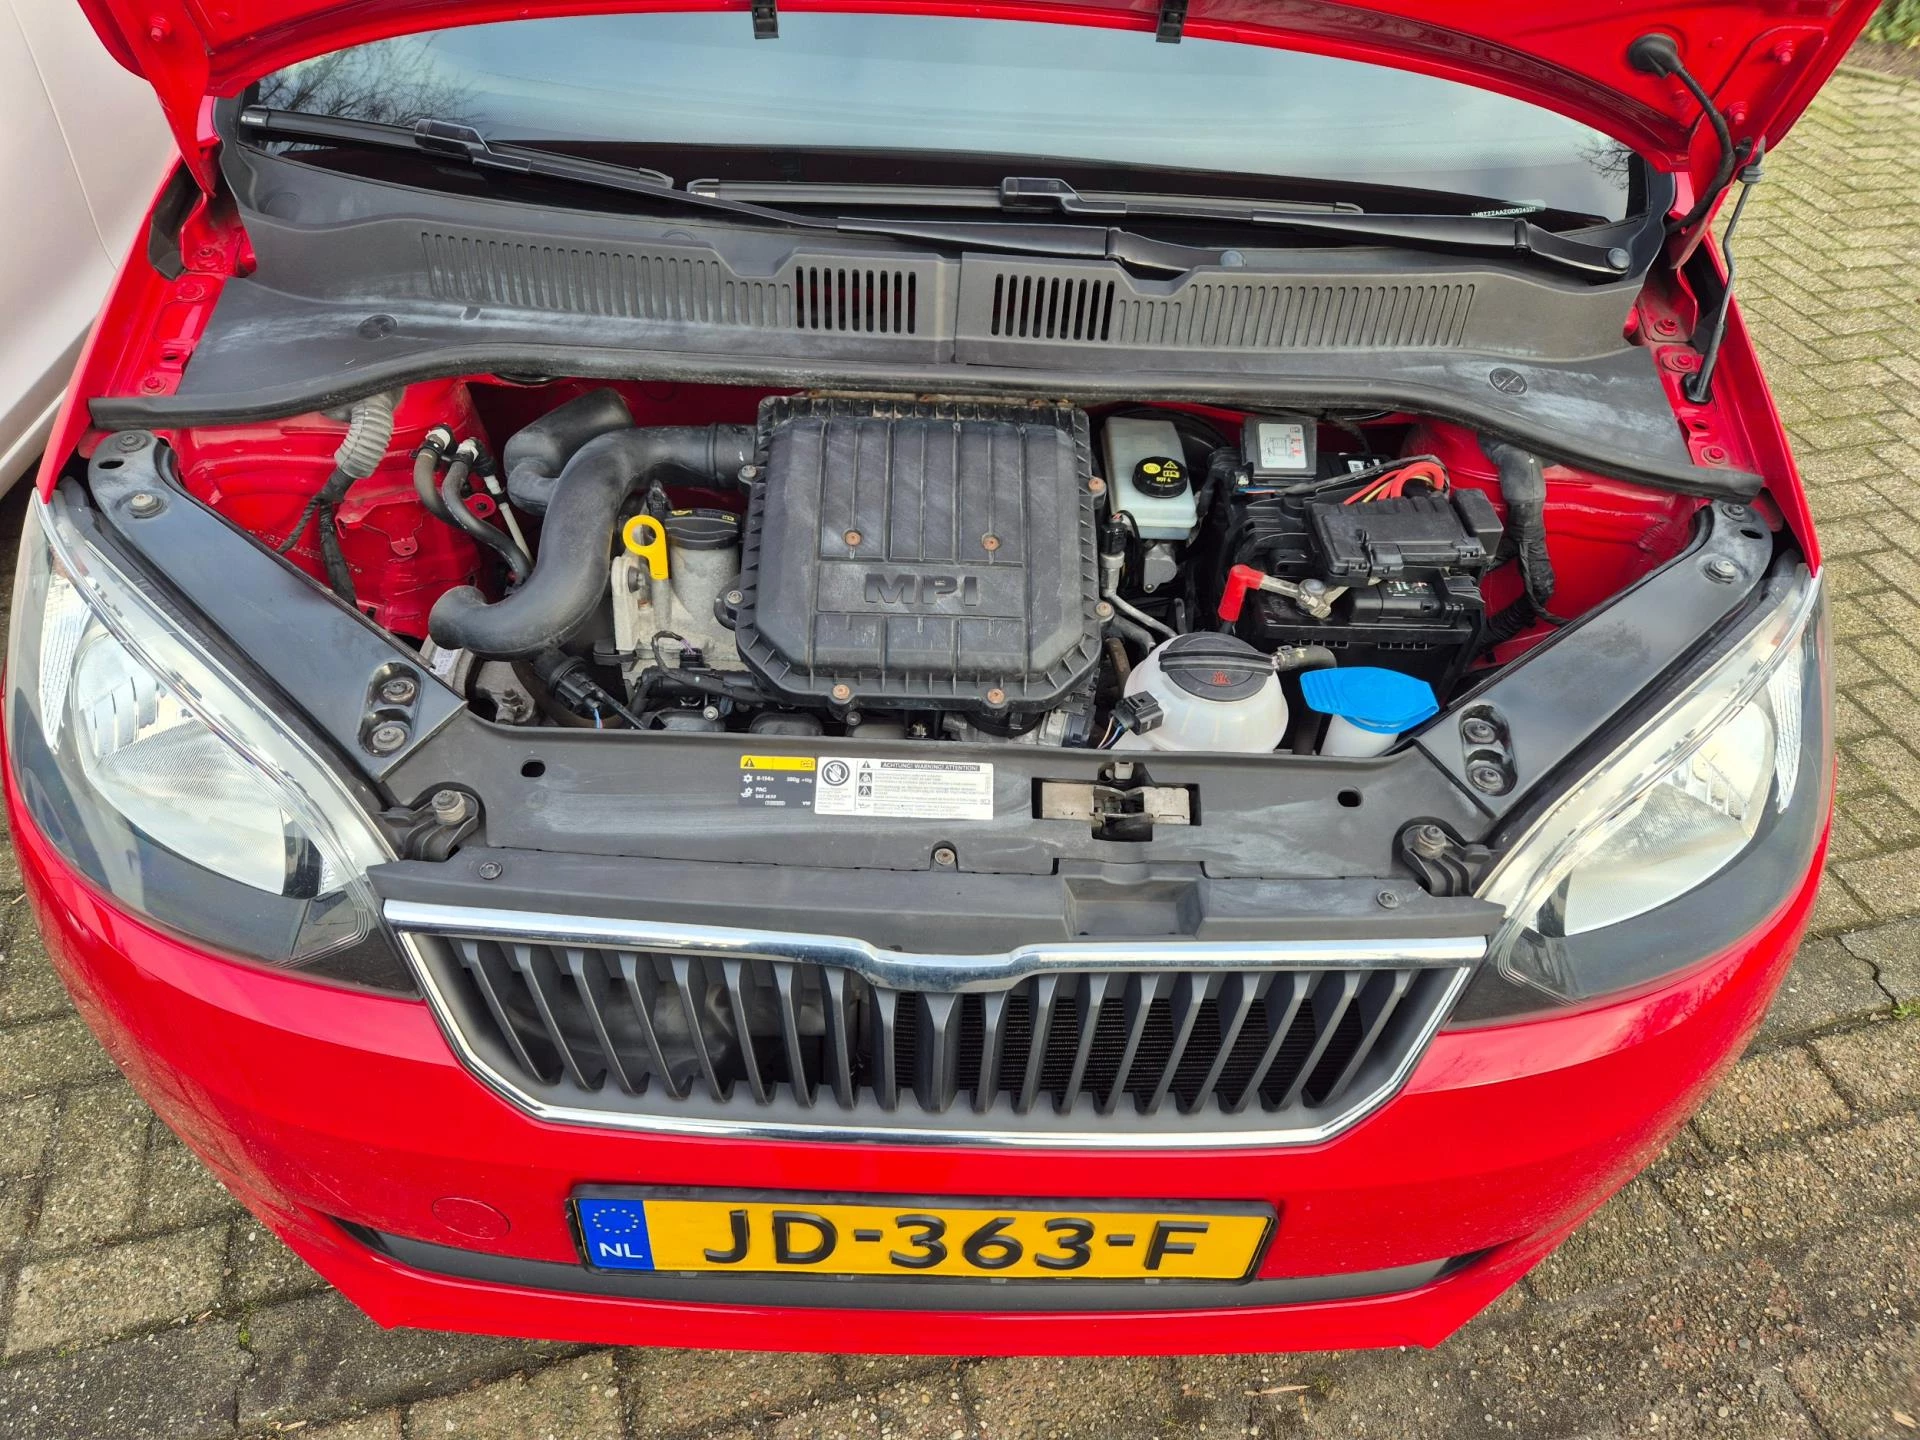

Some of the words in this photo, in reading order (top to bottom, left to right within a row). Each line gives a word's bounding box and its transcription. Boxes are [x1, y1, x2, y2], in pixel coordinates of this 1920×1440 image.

[864, 573, 979, 607] MPI
[599, 1242, 643, 1259] NL
[704, 1210, 1210, 1270] JD-363-F
